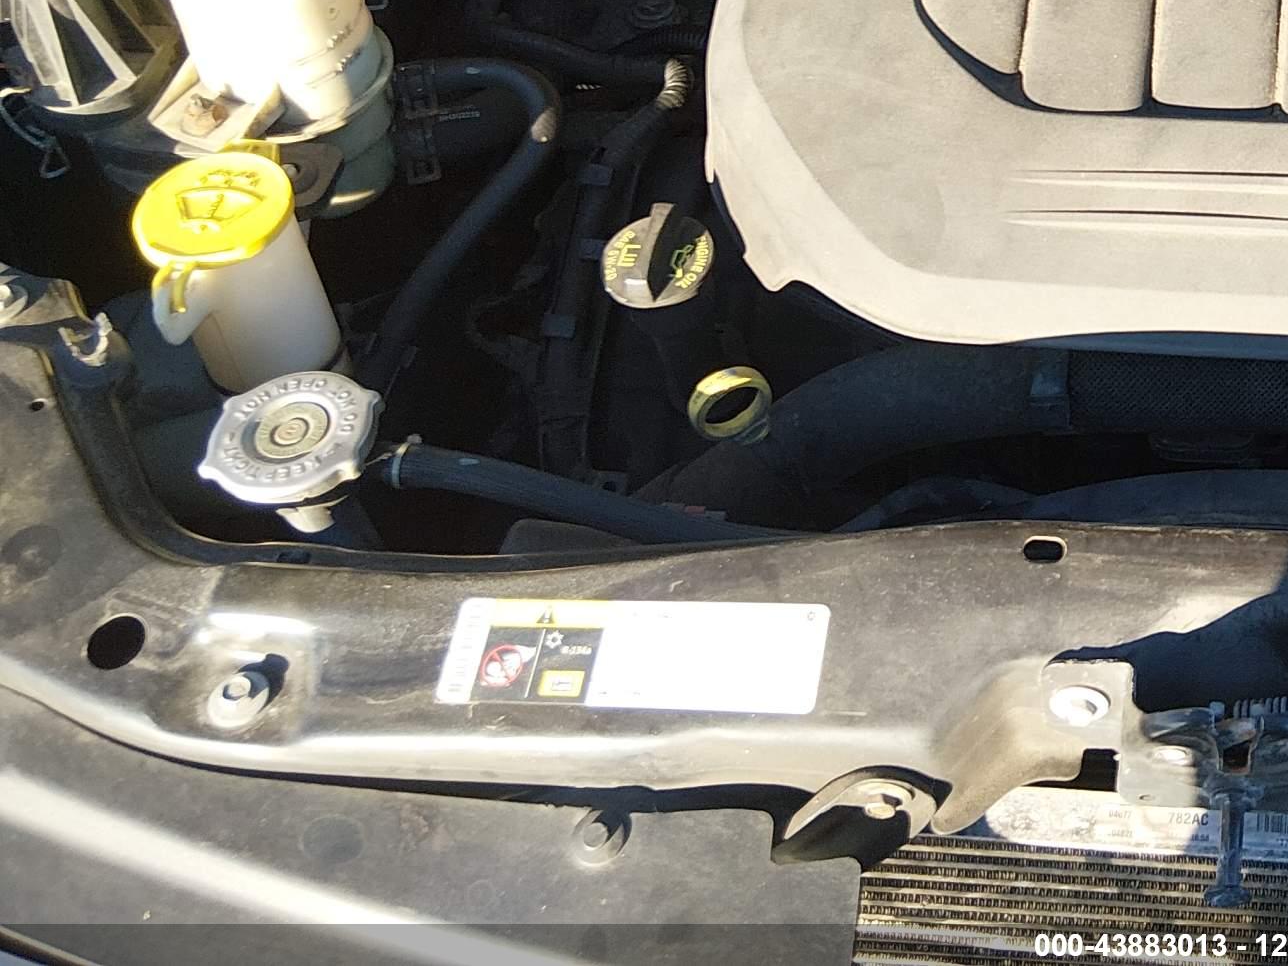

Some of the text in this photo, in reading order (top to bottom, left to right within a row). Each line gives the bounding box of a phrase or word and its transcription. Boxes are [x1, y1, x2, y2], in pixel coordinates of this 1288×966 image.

[274, 377, 329, 395] OPEN
[261, 453, 323, 483] KEEP
[1167, 812, 1209, 826] 782AC
